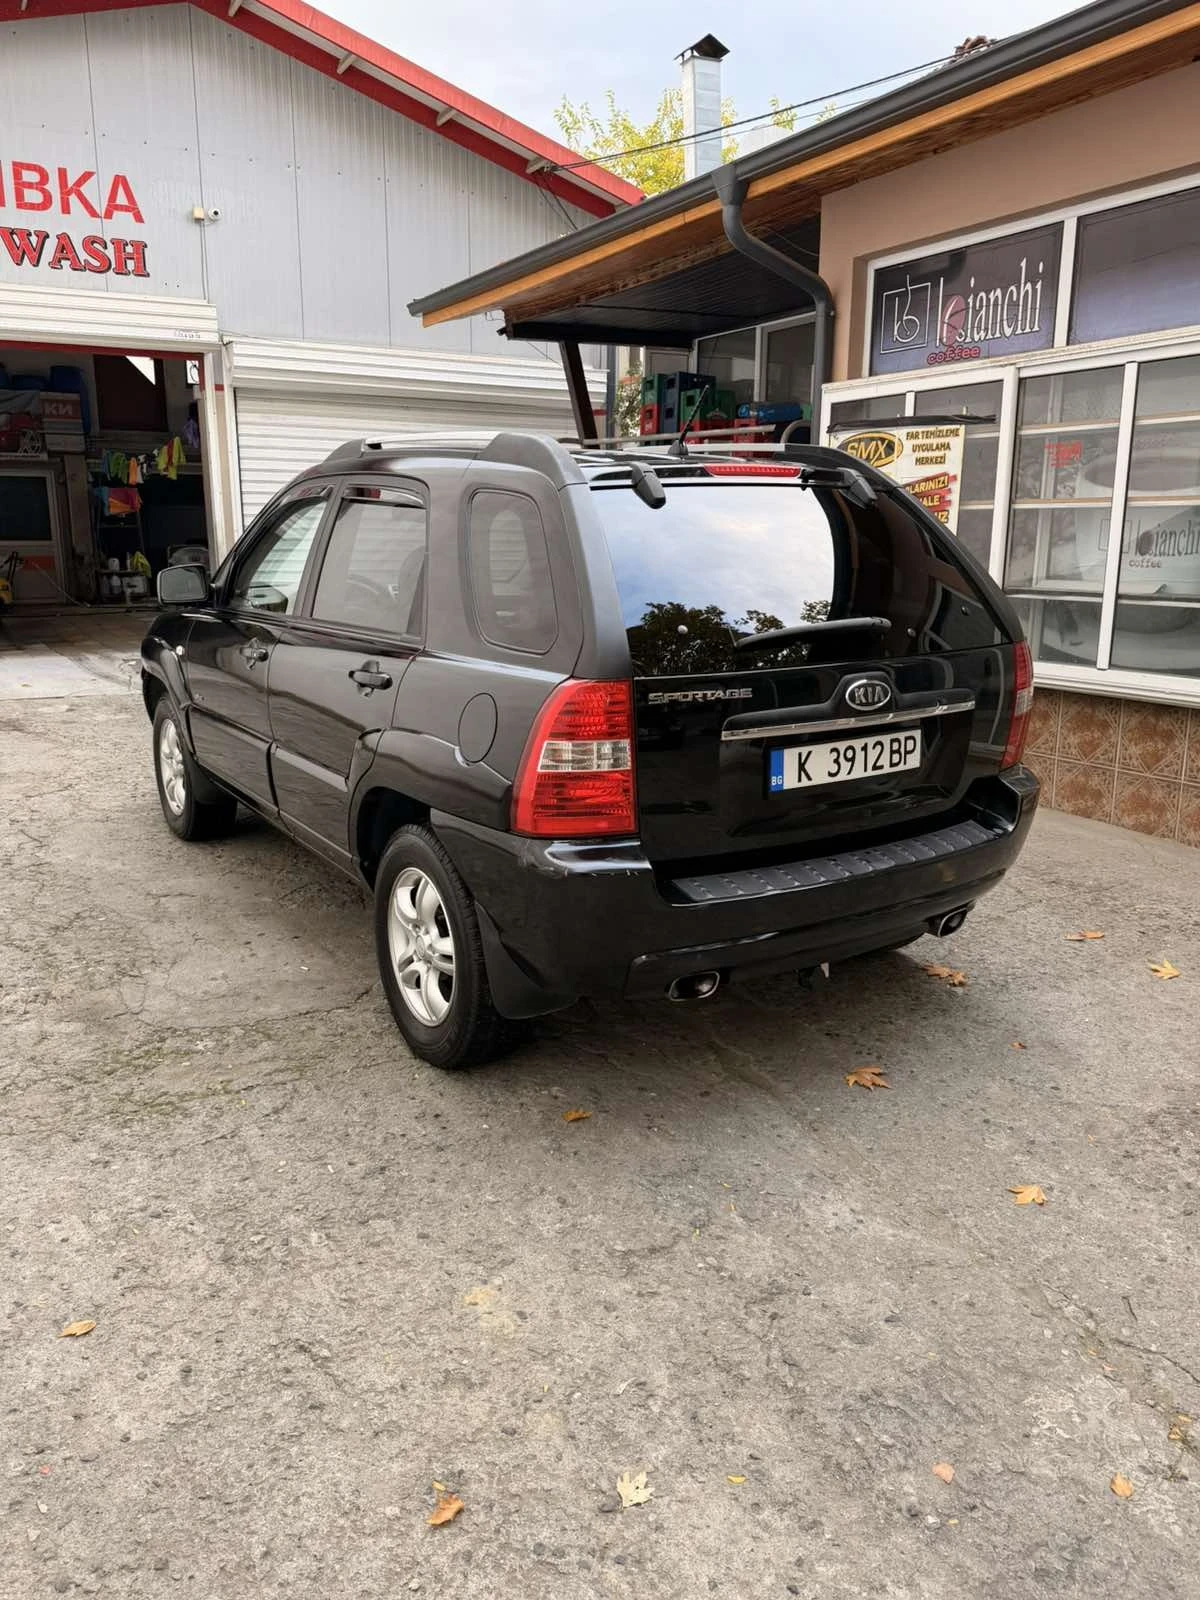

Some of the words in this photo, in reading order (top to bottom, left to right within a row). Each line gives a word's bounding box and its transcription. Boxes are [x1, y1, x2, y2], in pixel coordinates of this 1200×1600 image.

[0, 227, 150, 277] WASH
[927, 346, 981, 365] coffee
[906, 431, 920, 440] FAR
[921, 427, 960, 440] TEMİZLEME
[847, 440, 889, 465] SMX
[912, 442, 951, 453] UYGULAMA
[915, 453, 946, 466] MERKEZİ
[920, 495, 941, 507] ALE
[1128, 559, 1162, 568] coffee
[648, 688, 752, 704] SPORTAGE
[855, 686, 884, 704] KIA
[797, 750, 813, 783] K
[771, 776, 783, 785] BG
